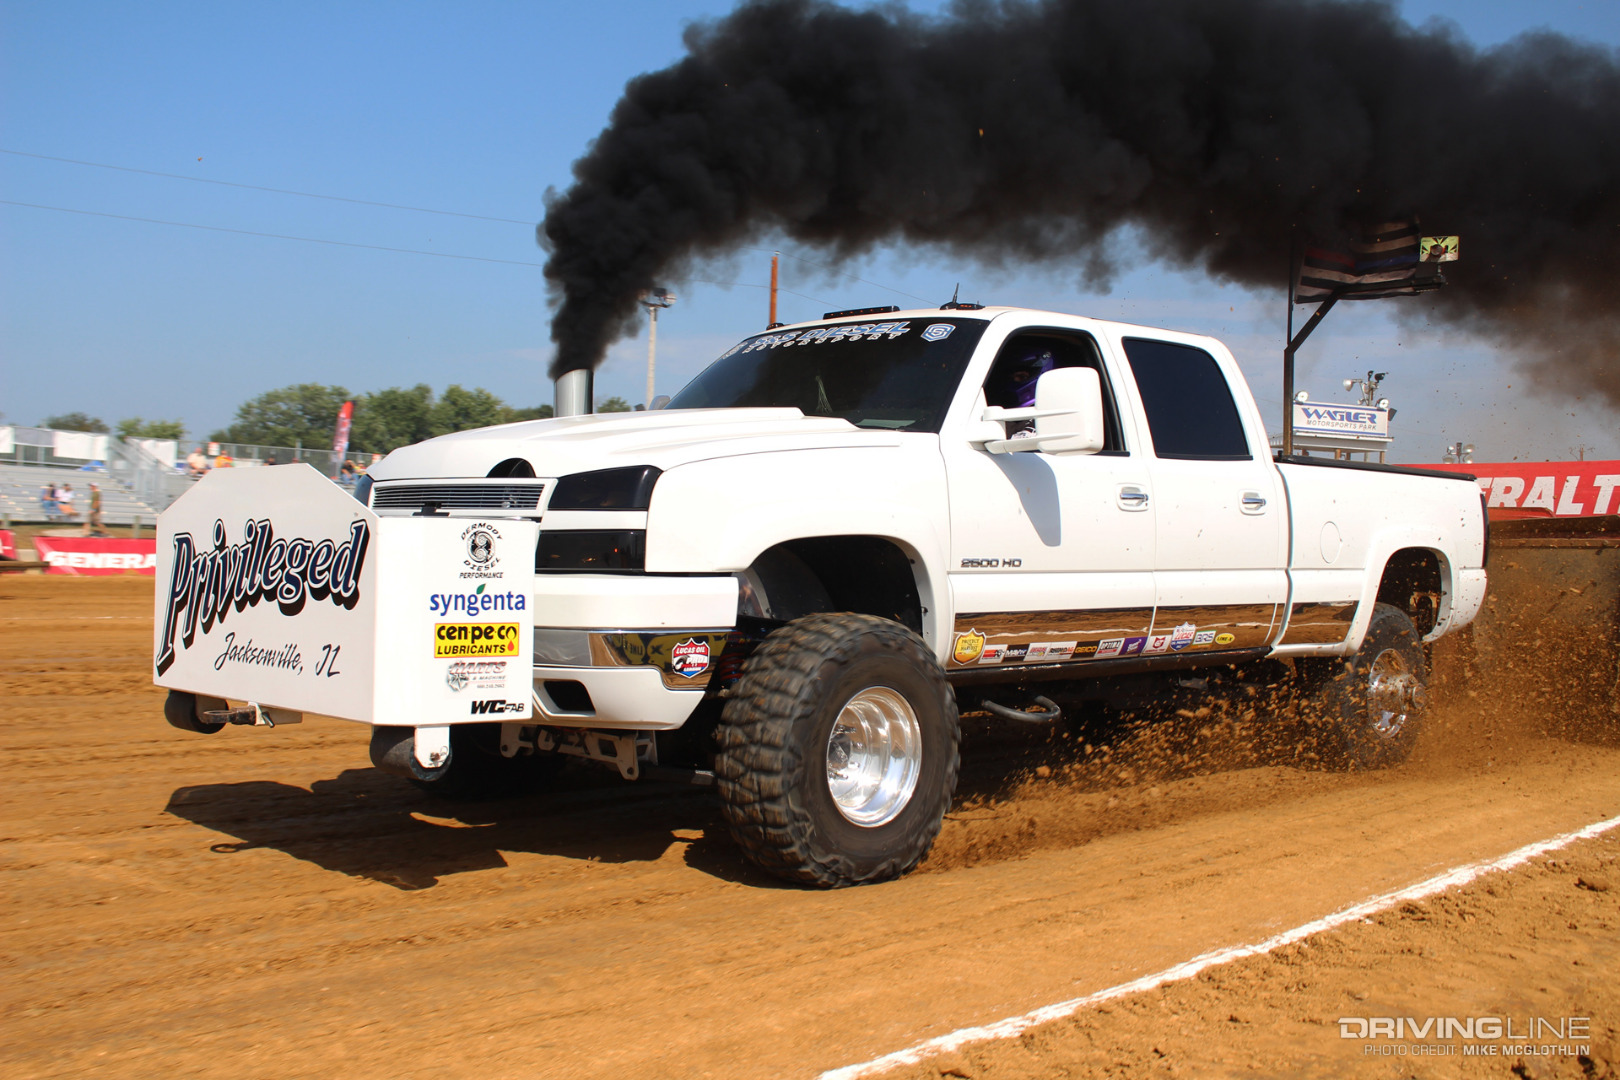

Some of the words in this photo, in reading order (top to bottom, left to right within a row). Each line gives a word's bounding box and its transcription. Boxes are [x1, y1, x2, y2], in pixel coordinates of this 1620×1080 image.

[797, 321, 911, 342] DIESEL
[1302, 407, 1377, 424] WAGLER
[1307, 419, 1359, 429] MOTORSPORTS
[461, 522, 503, 540] DERMODY
[463, 557, 501, 571] DIESEL
[961, 558, 999, 568] 2500
[1002, 558, 1022, 568] HD
[156, 518, 370, 677] Privileged
[430, 591, 526, 617] syngenta
[437, 644, 506, 655] LUBRICANTS
[675, 646, 695, 655] LUCAS
[1075, 646, 1098, 654] GEICO
[1101, 640, 1122, 650] OPTIMA
[214, 631, 304, 676] Jacksonville,
